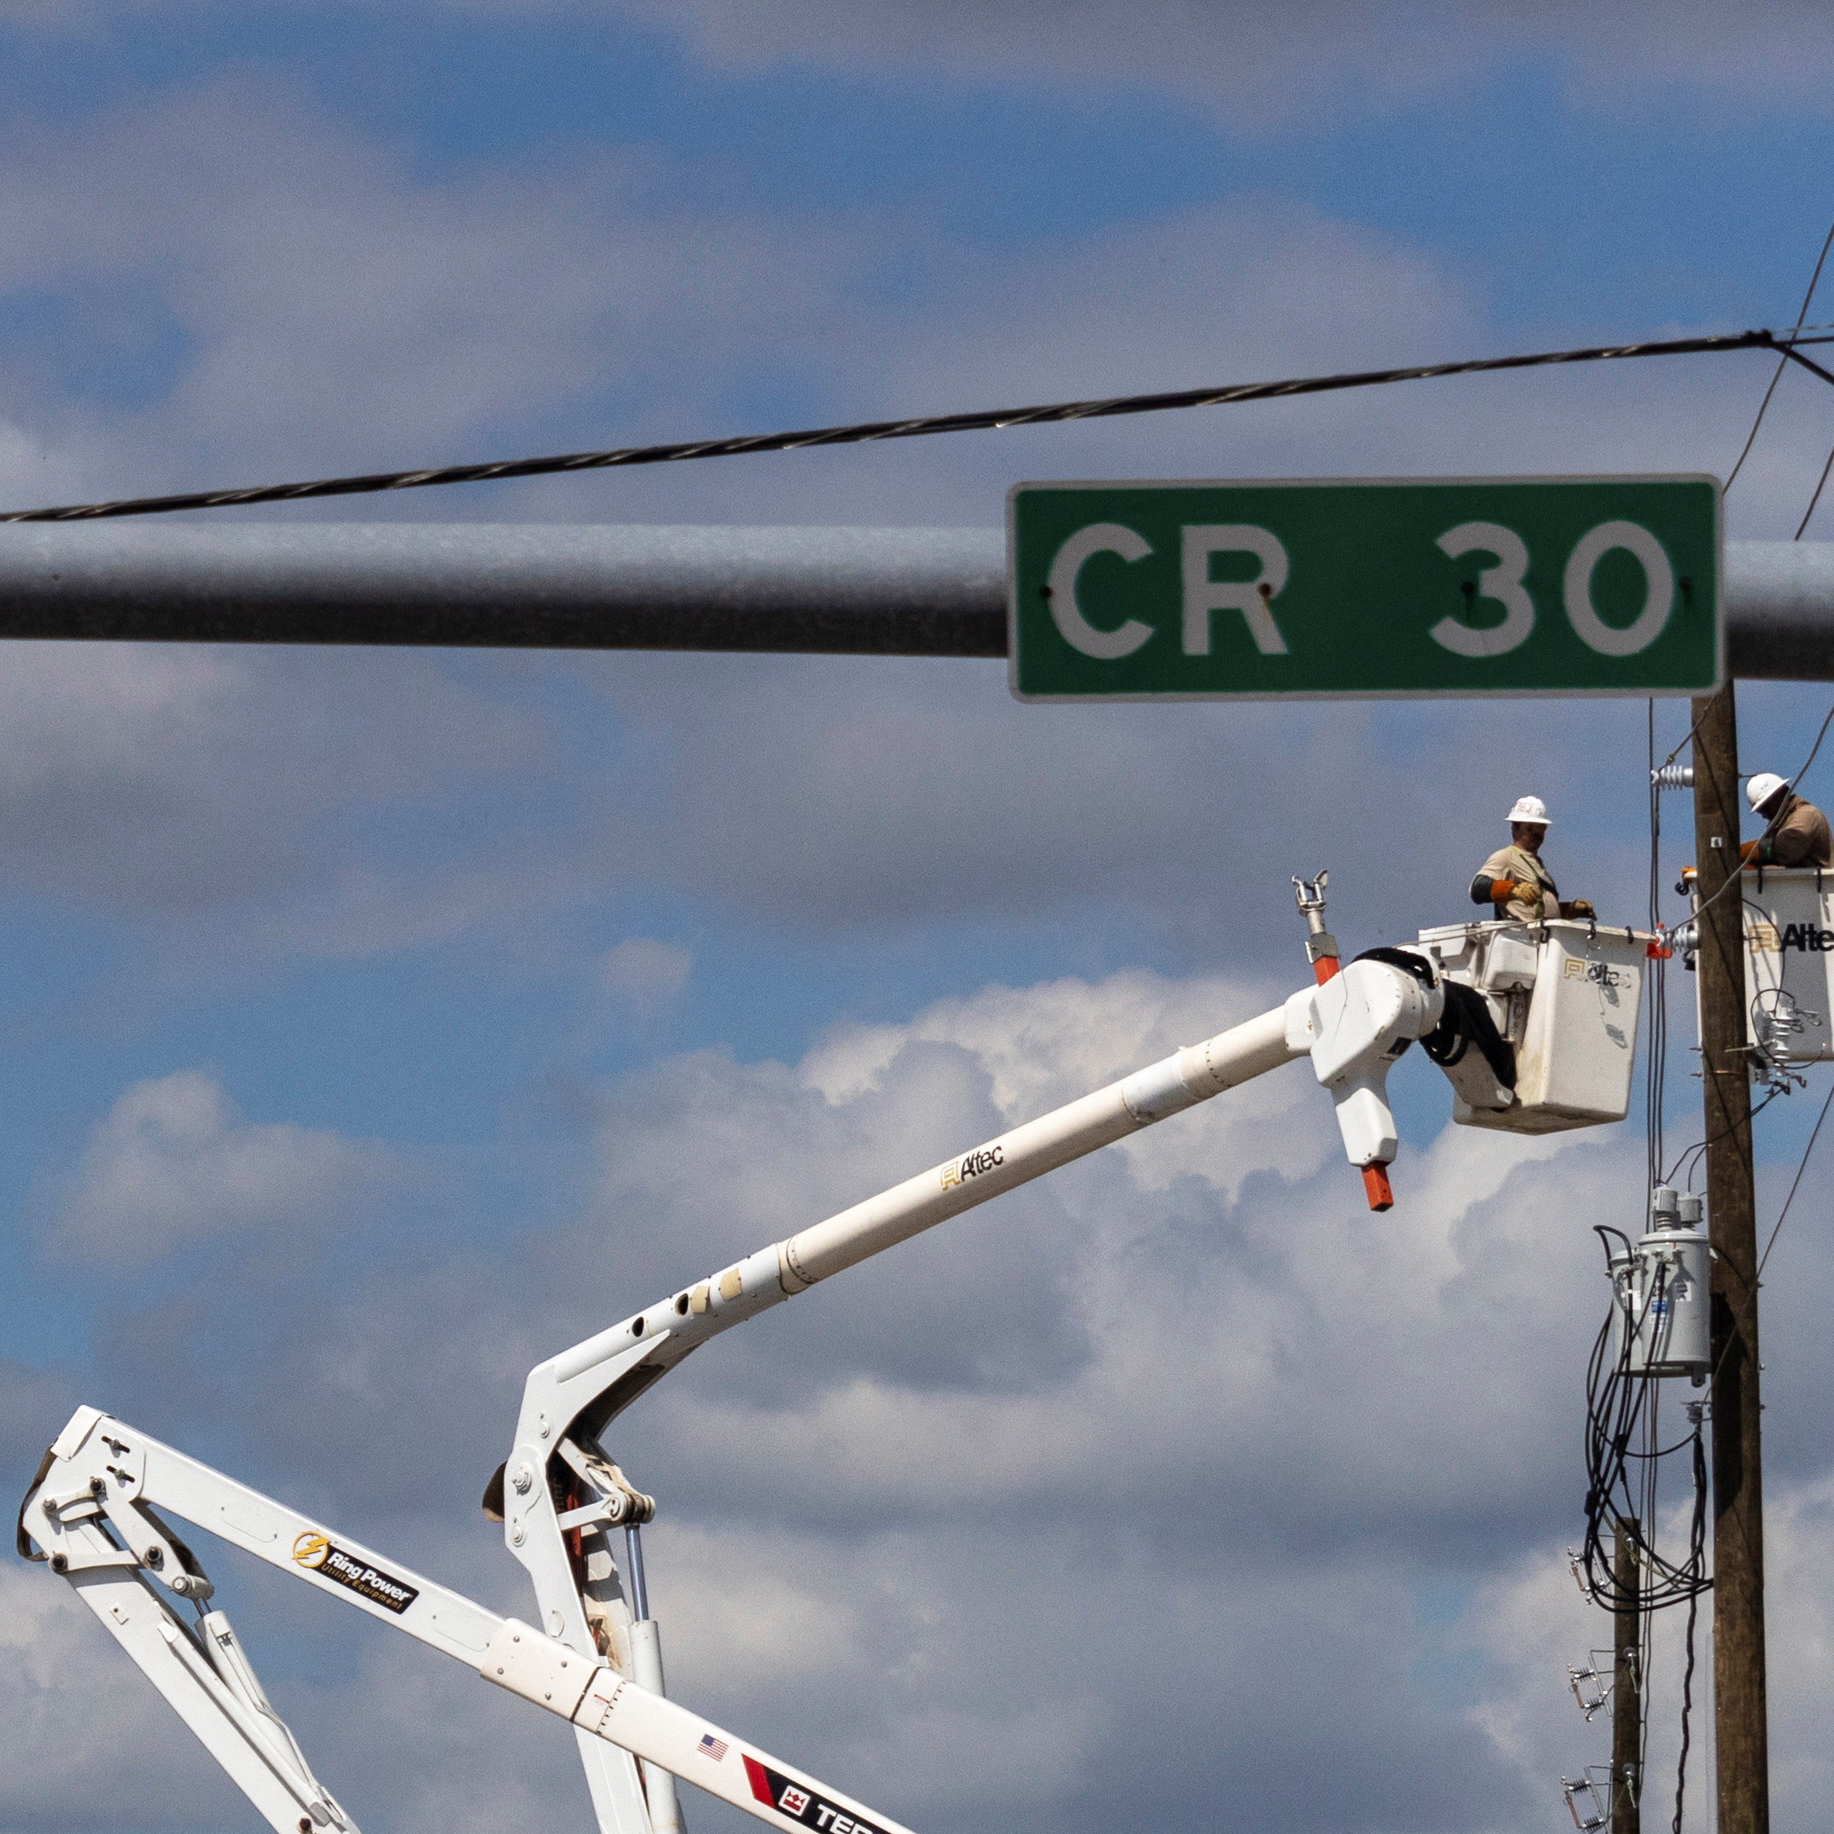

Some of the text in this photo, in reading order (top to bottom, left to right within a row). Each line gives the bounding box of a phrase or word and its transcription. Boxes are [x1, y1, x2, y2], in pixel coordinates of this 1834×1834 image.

[1048, 520, 1675, 659] CR 30
[961, 1146, 1003, 1182] Altec
[321, 1564, 403, 1610] Utility Equipment
[327, 1552, 411, 1601] Ring Power
